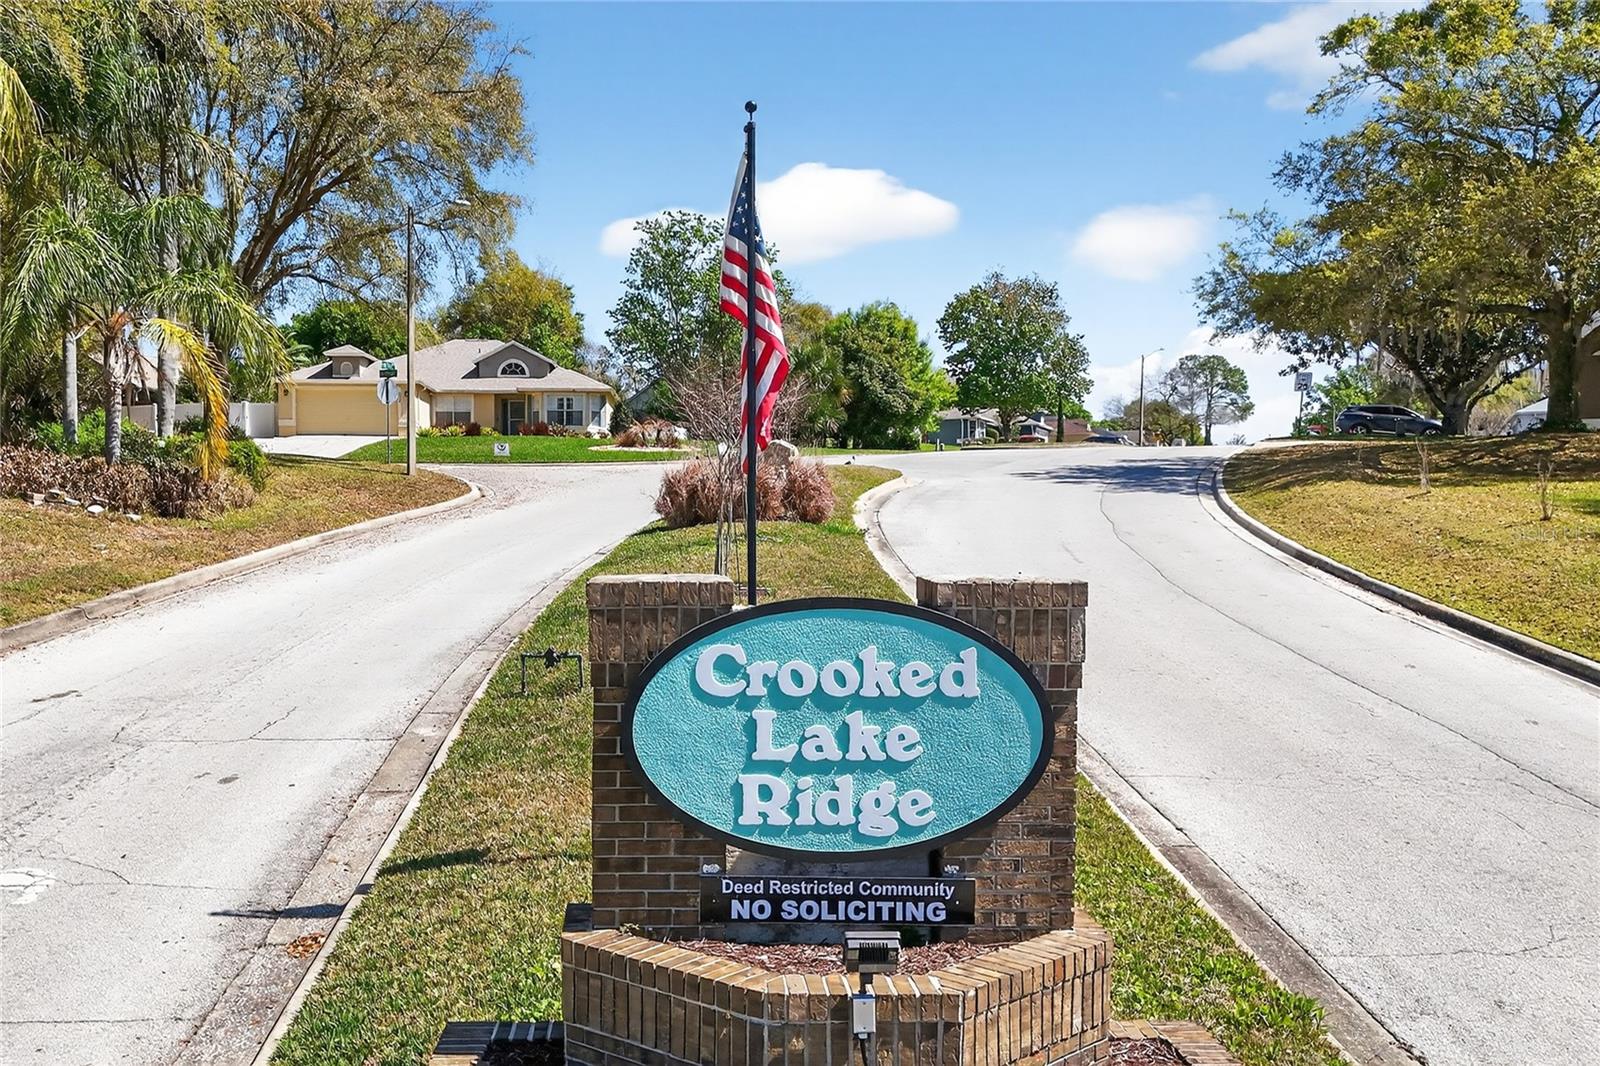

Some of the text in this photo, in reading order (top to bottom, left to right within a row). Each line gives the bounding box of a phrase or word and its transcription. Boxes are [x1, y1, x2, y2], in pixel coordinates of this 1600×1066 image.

[695, 643, 981, 698] Crooked
[751, 709, 925, 763] Lake
[738, 773, 937, 837] Ridge
[721, 879, 956, 899] Deed Restricted Community
[730, 899, 947, 922] NO SOLICITING
